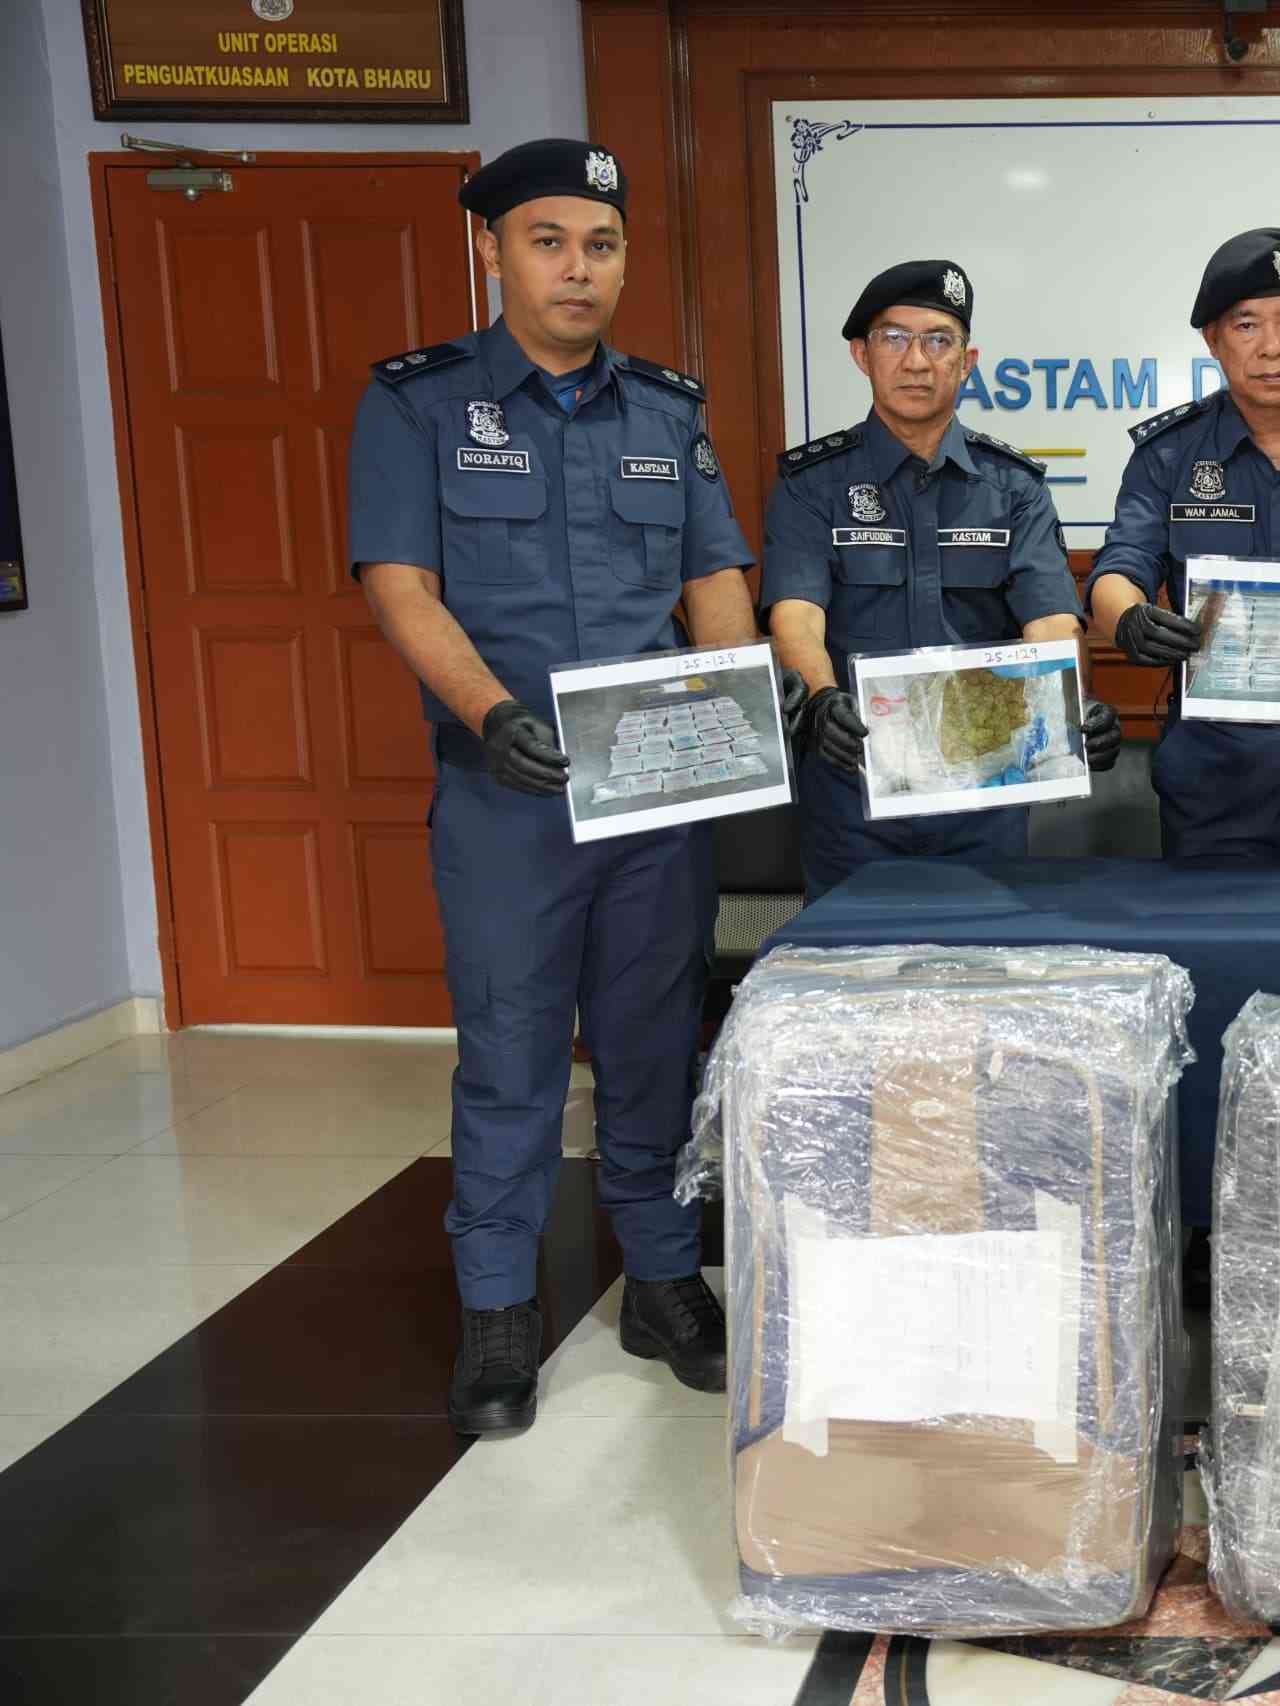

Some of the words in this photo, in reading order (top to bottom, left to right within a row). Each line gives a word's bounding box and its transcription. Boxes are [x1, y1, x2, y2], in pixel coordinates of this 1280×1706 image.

[218, 32, 260, 53] UNIT
[264, 32, 338, 54] OPERASI
[123, 64, 289, 87] PENGUATKUASAAN
[306, 68, 359, 88] KOTA
[364, 68, 431, 89] BHARU
[957, 358, 1158, 411] ASTAM
[463, 452, 525, 468] NORAFIQ
[630, 463, 671, 474] KASTAM
[1184, 508, 1206, 518] WAN
[1210, 508, 1241, 518] JAMAL
[951, 532, 992, 543] KASTAM
[984, 647, 1039, 664] 25-129
